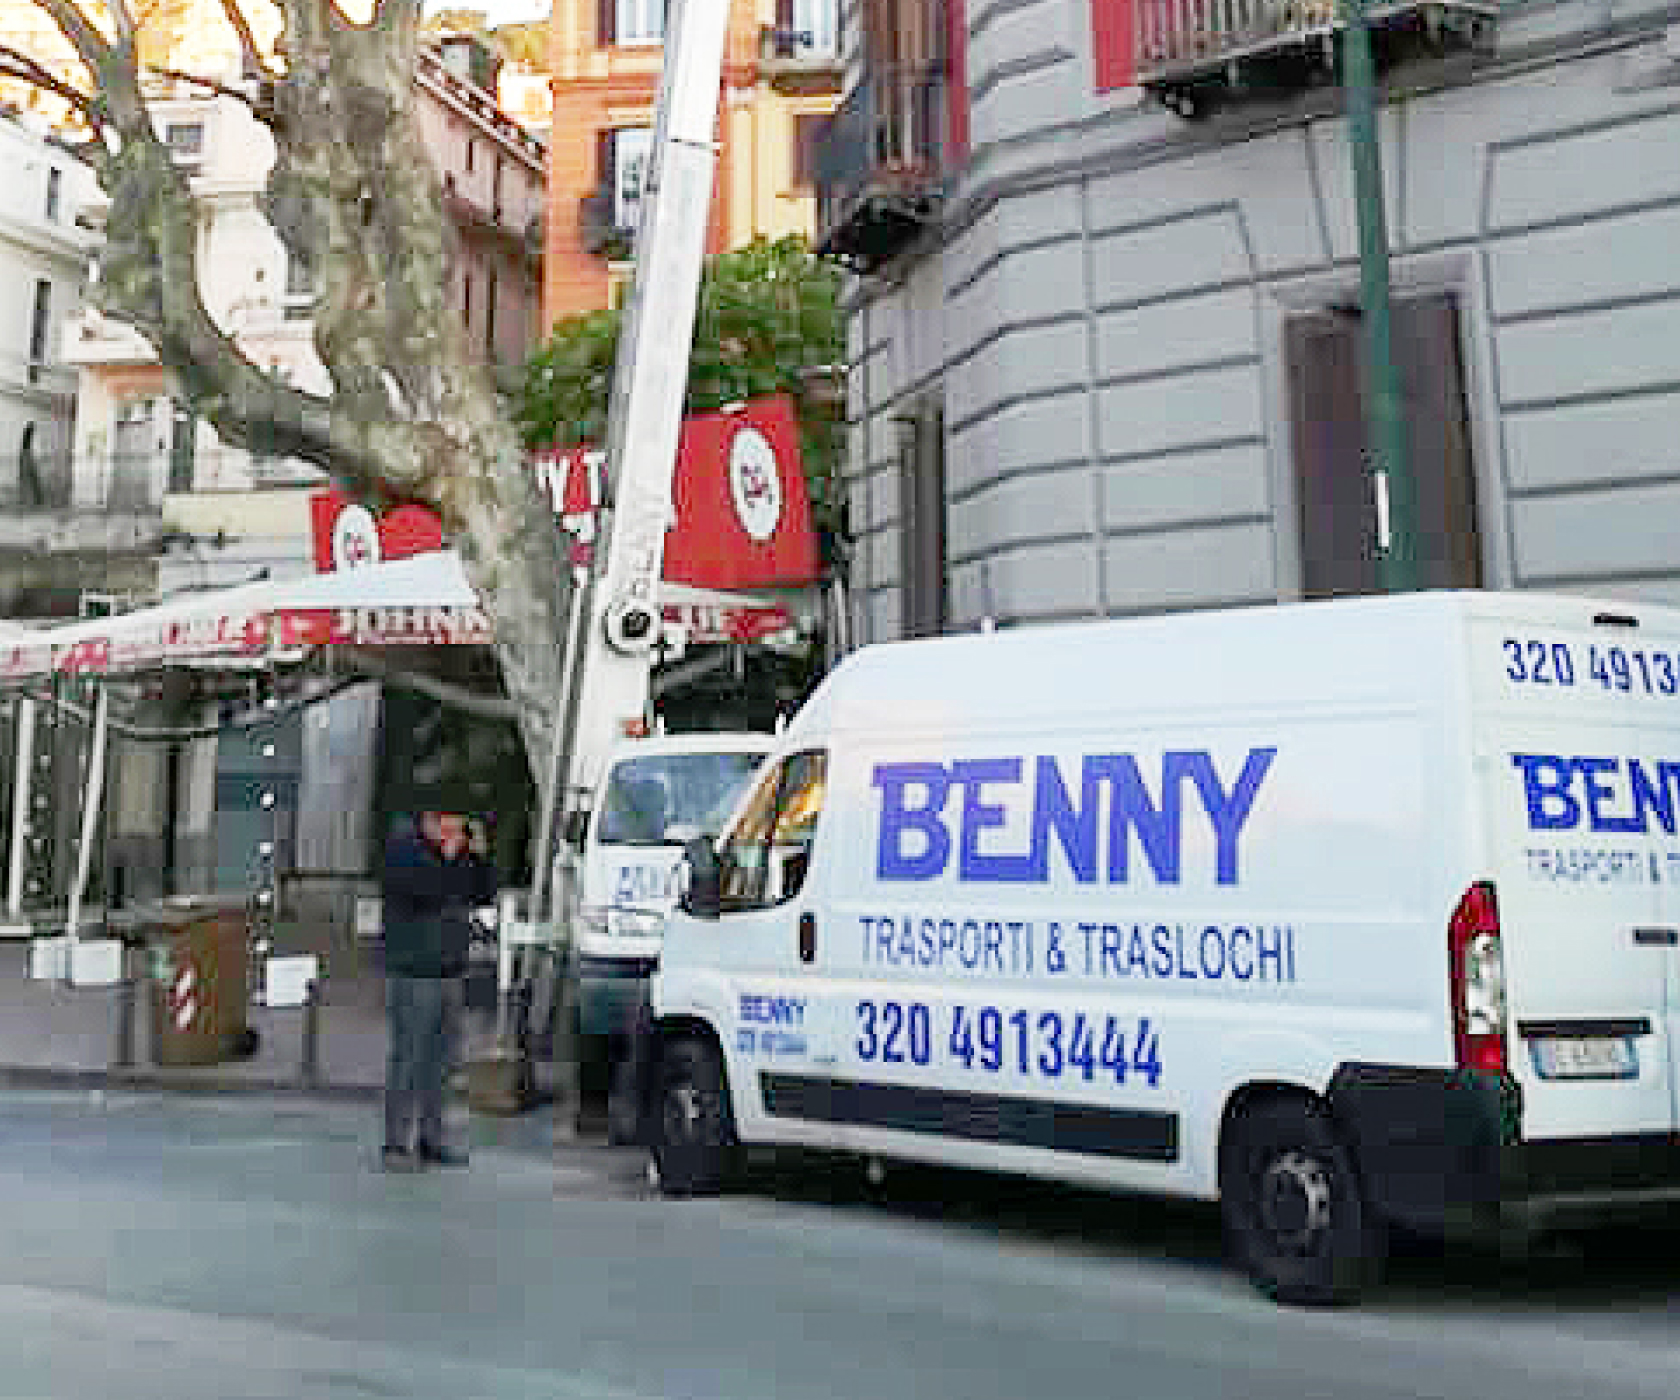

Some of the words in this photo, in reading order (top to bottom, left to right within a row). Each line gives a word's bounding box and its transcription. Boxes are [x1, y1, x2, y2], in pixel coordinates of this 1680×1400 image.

[1502, 639, 1574, 687] 320
[1589, 644, 1680, 694] 4913
[872, 748, 1278, 885] BENNY
[1511, 754, 1680, 834] BEN
[859, 916, 1034, 972] TRASPORTI
[1046, 922, 1066, 974] &
[1078, 922, 1295, 982] TRASLOCHI
[856, 1001, 931, 1066] 320
[948, 1005, 1163, 1087] 4913444
